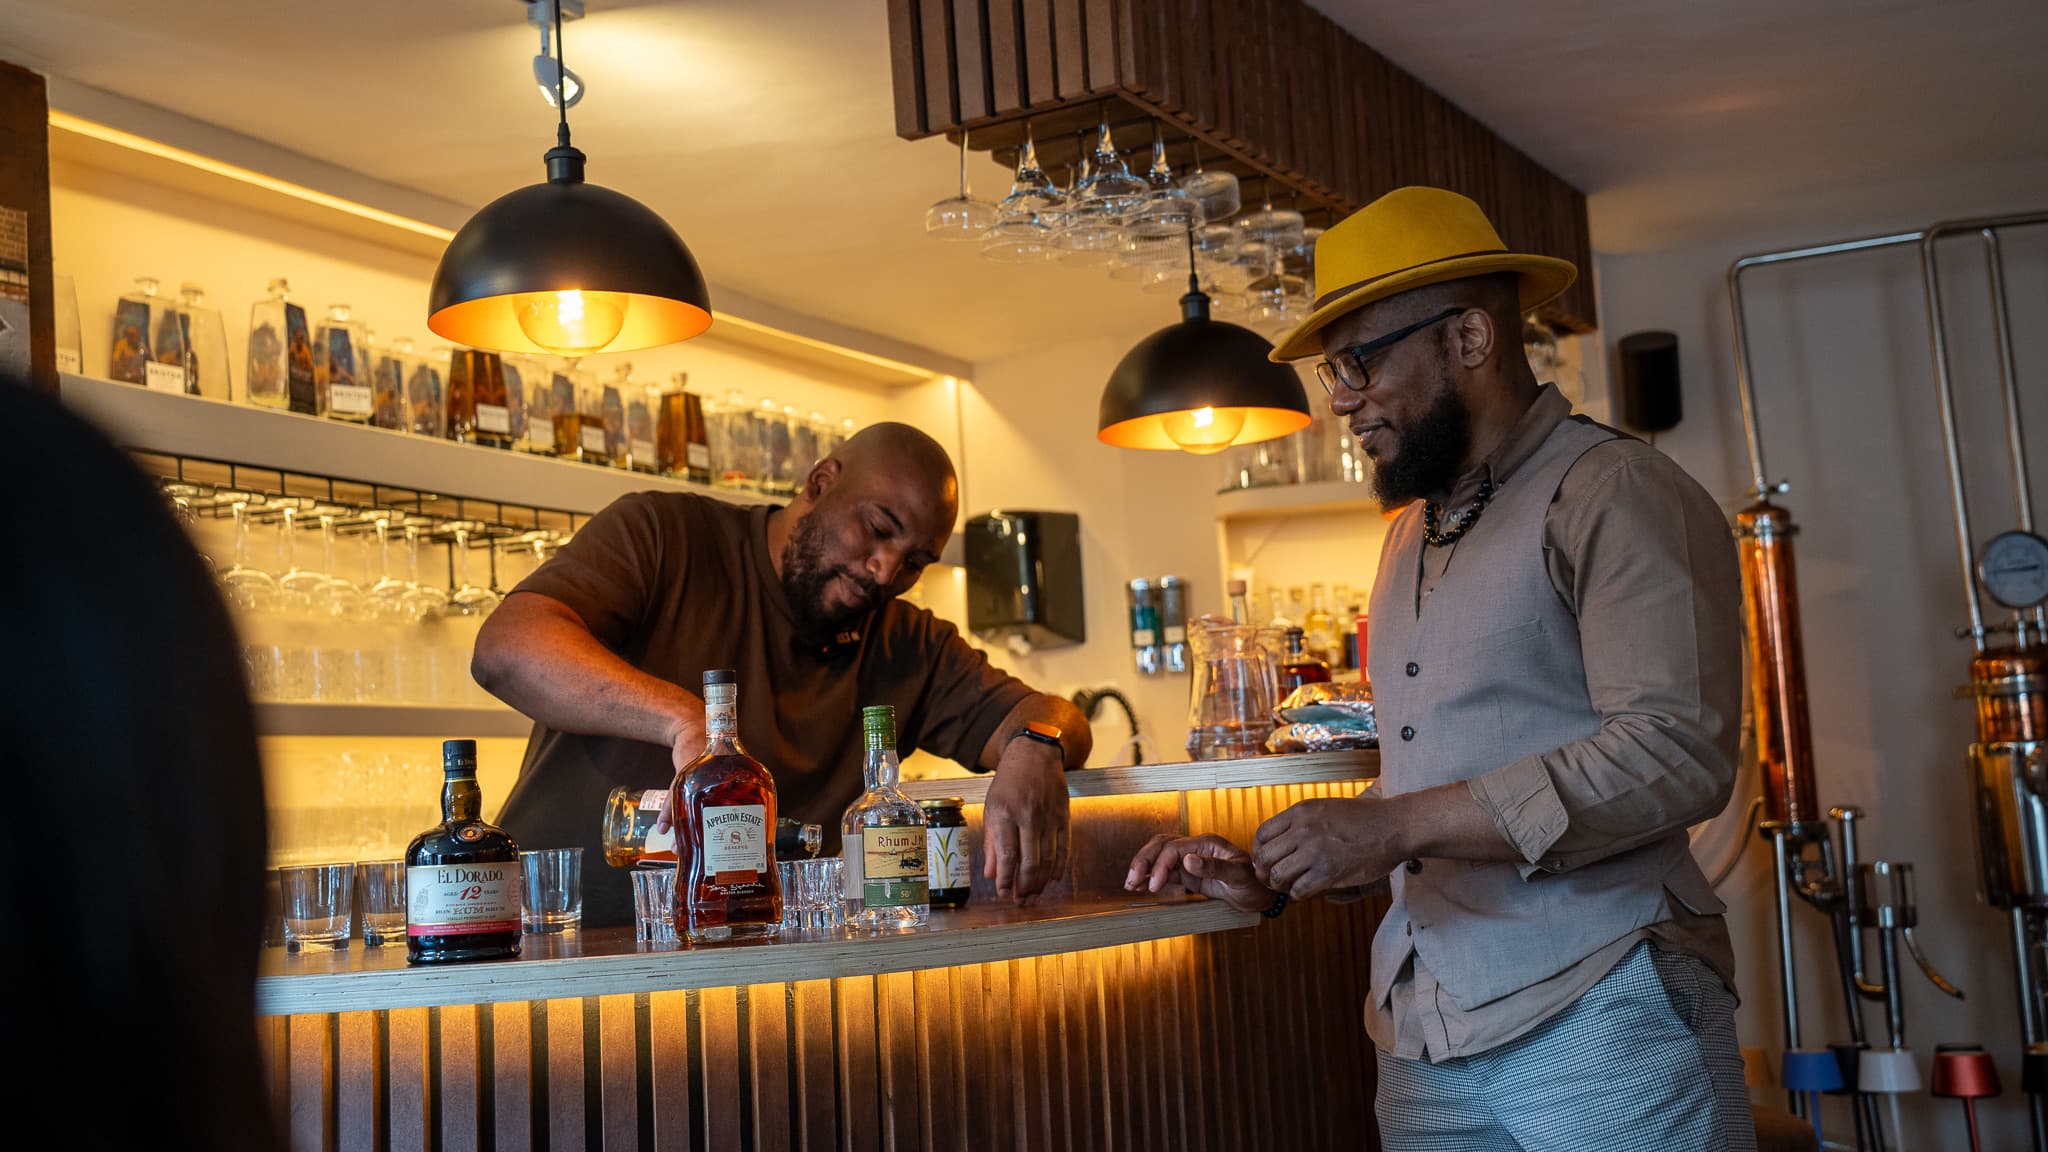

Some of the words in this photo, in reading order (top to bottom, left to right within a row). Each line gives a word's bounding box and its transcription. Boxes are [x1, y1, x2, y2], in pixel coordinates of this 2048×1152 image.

[706, 812, 739, 829] APPLETON
[740, 812, 763, 826] ESTATE
[730, 831, 741, 844] 8
[878, 835, 909, 847] Rhum
[438, 869, 453, 884] EL
[455, 868, 504, 884] DORADO
[460, 885, 482, 900] 12
